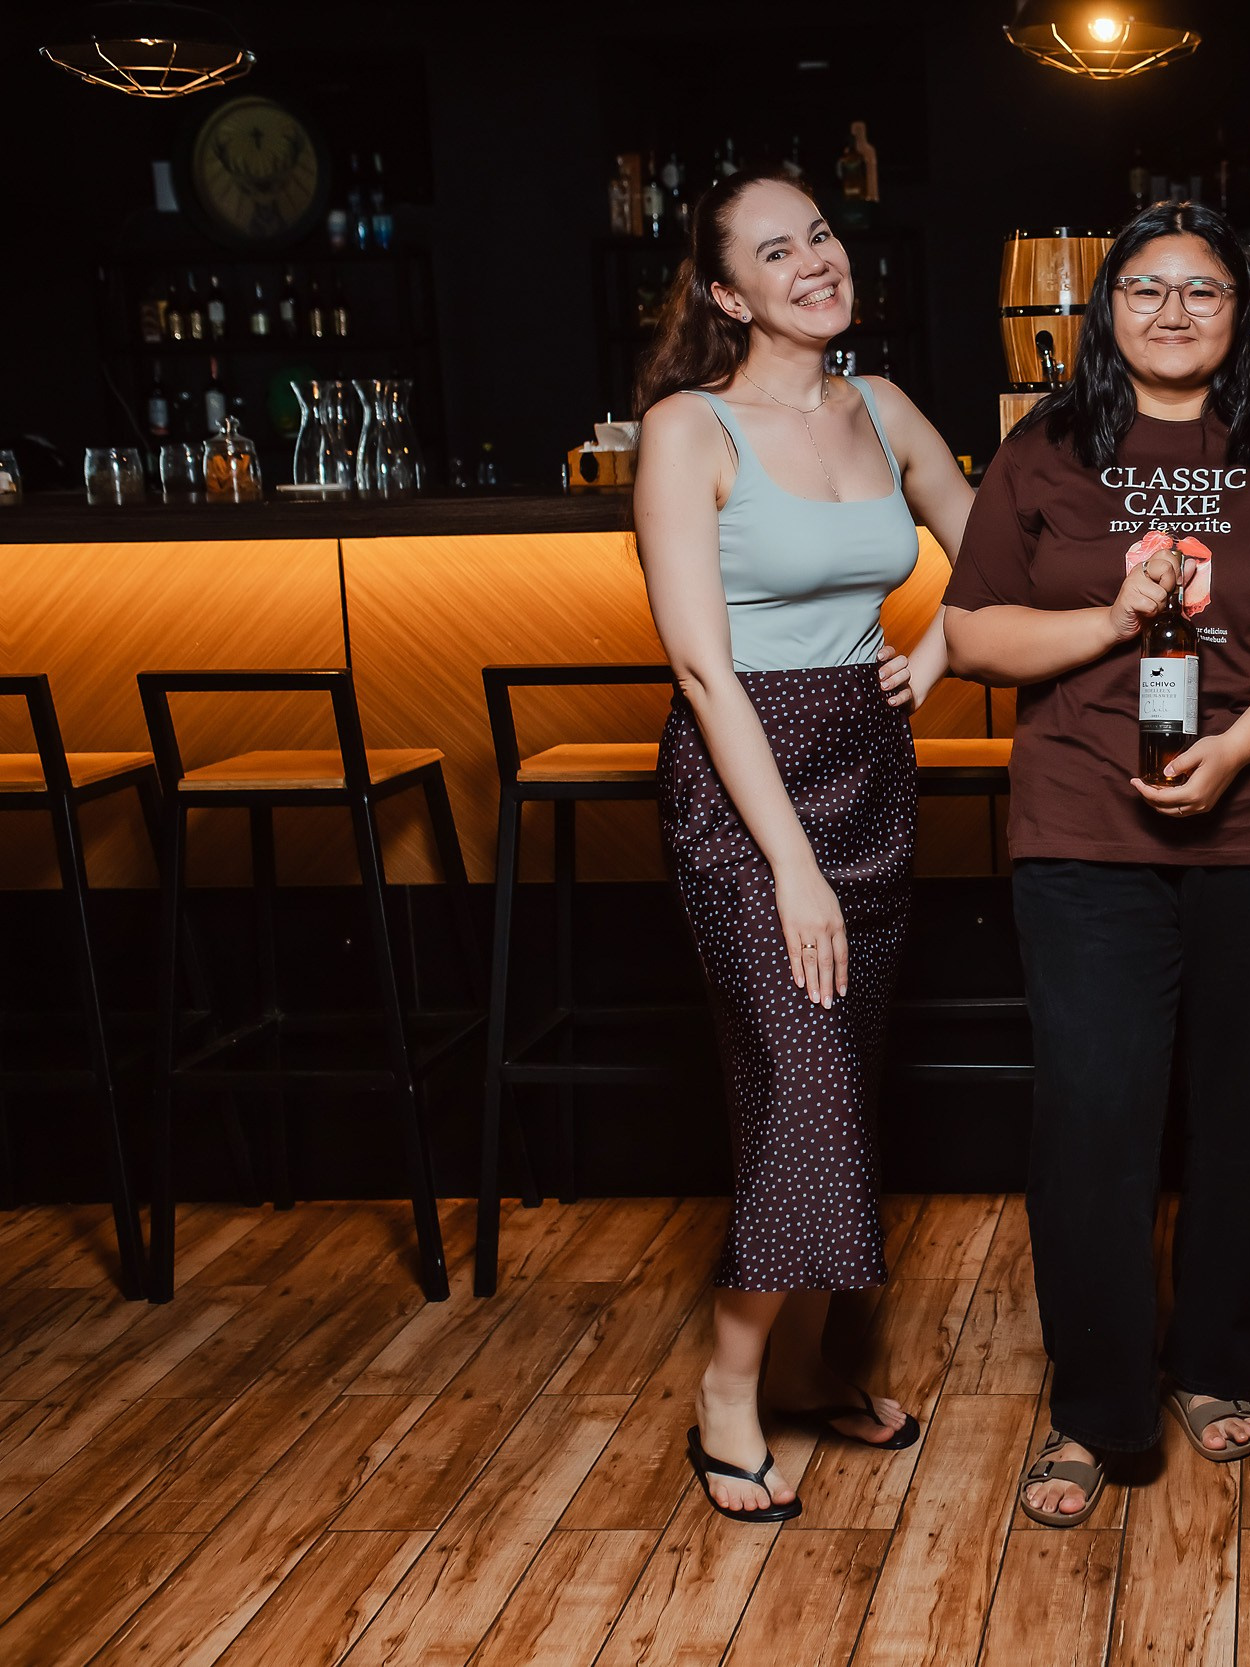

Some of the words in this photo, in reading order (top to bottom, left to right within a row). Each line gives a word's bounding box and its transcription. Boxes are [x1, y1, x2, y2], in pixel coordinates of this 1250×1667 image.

[1100, 467, 1247, 491] CLASSIC
[1124, 492, 1220, 516] CAKE
[1109, 520, 1144, 533] my
[1148, 517, 1231, 533] favorite
[1204, 627, 1227, 635] delicious
